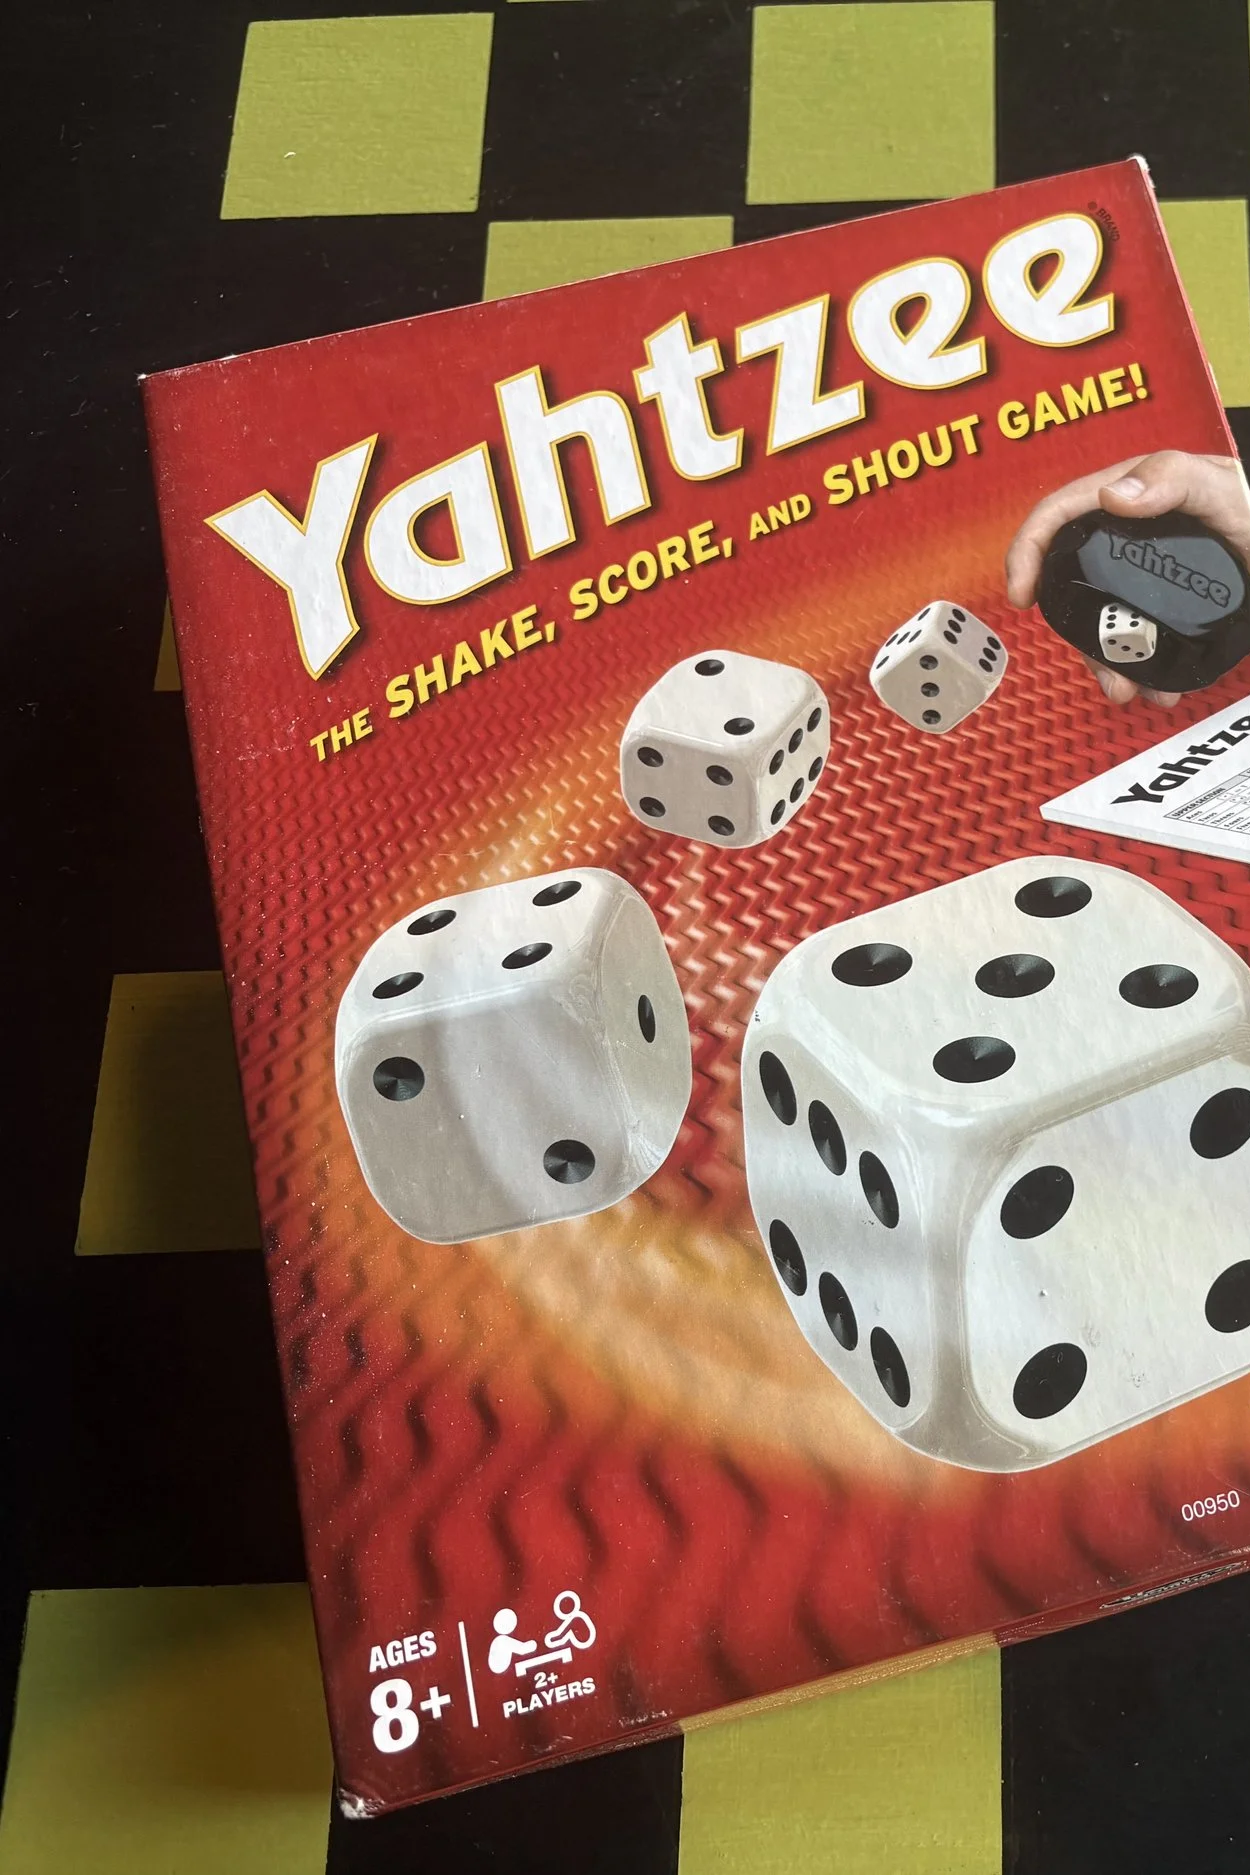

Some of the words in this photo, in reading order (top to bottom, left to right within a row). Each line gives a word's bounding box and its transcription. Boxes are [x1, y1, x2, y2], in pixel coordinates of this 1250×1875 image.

[204, 212, 1115, 681] Yahtzee
[309, 706, 375, 763] THE
[386, 604, 557, 719] SHAKE,
[568, 520, 735, 621] SCORE,
[749, 493, 813, 541] AND
[823, 414, 981, 506] SHOUT
[997, 362, 1149, 440] GAME!
[1102, 527, 1232, 609] Yahtzee
[1180, 1489, 1241, 1524] 00950
[368, 1631, 437, 1673] AGES
[533, 1671, 559, 1690] 2+
[369, 1677, 452, 1755] 8+
[501, 1676, 597, 1719] PLAYERS
